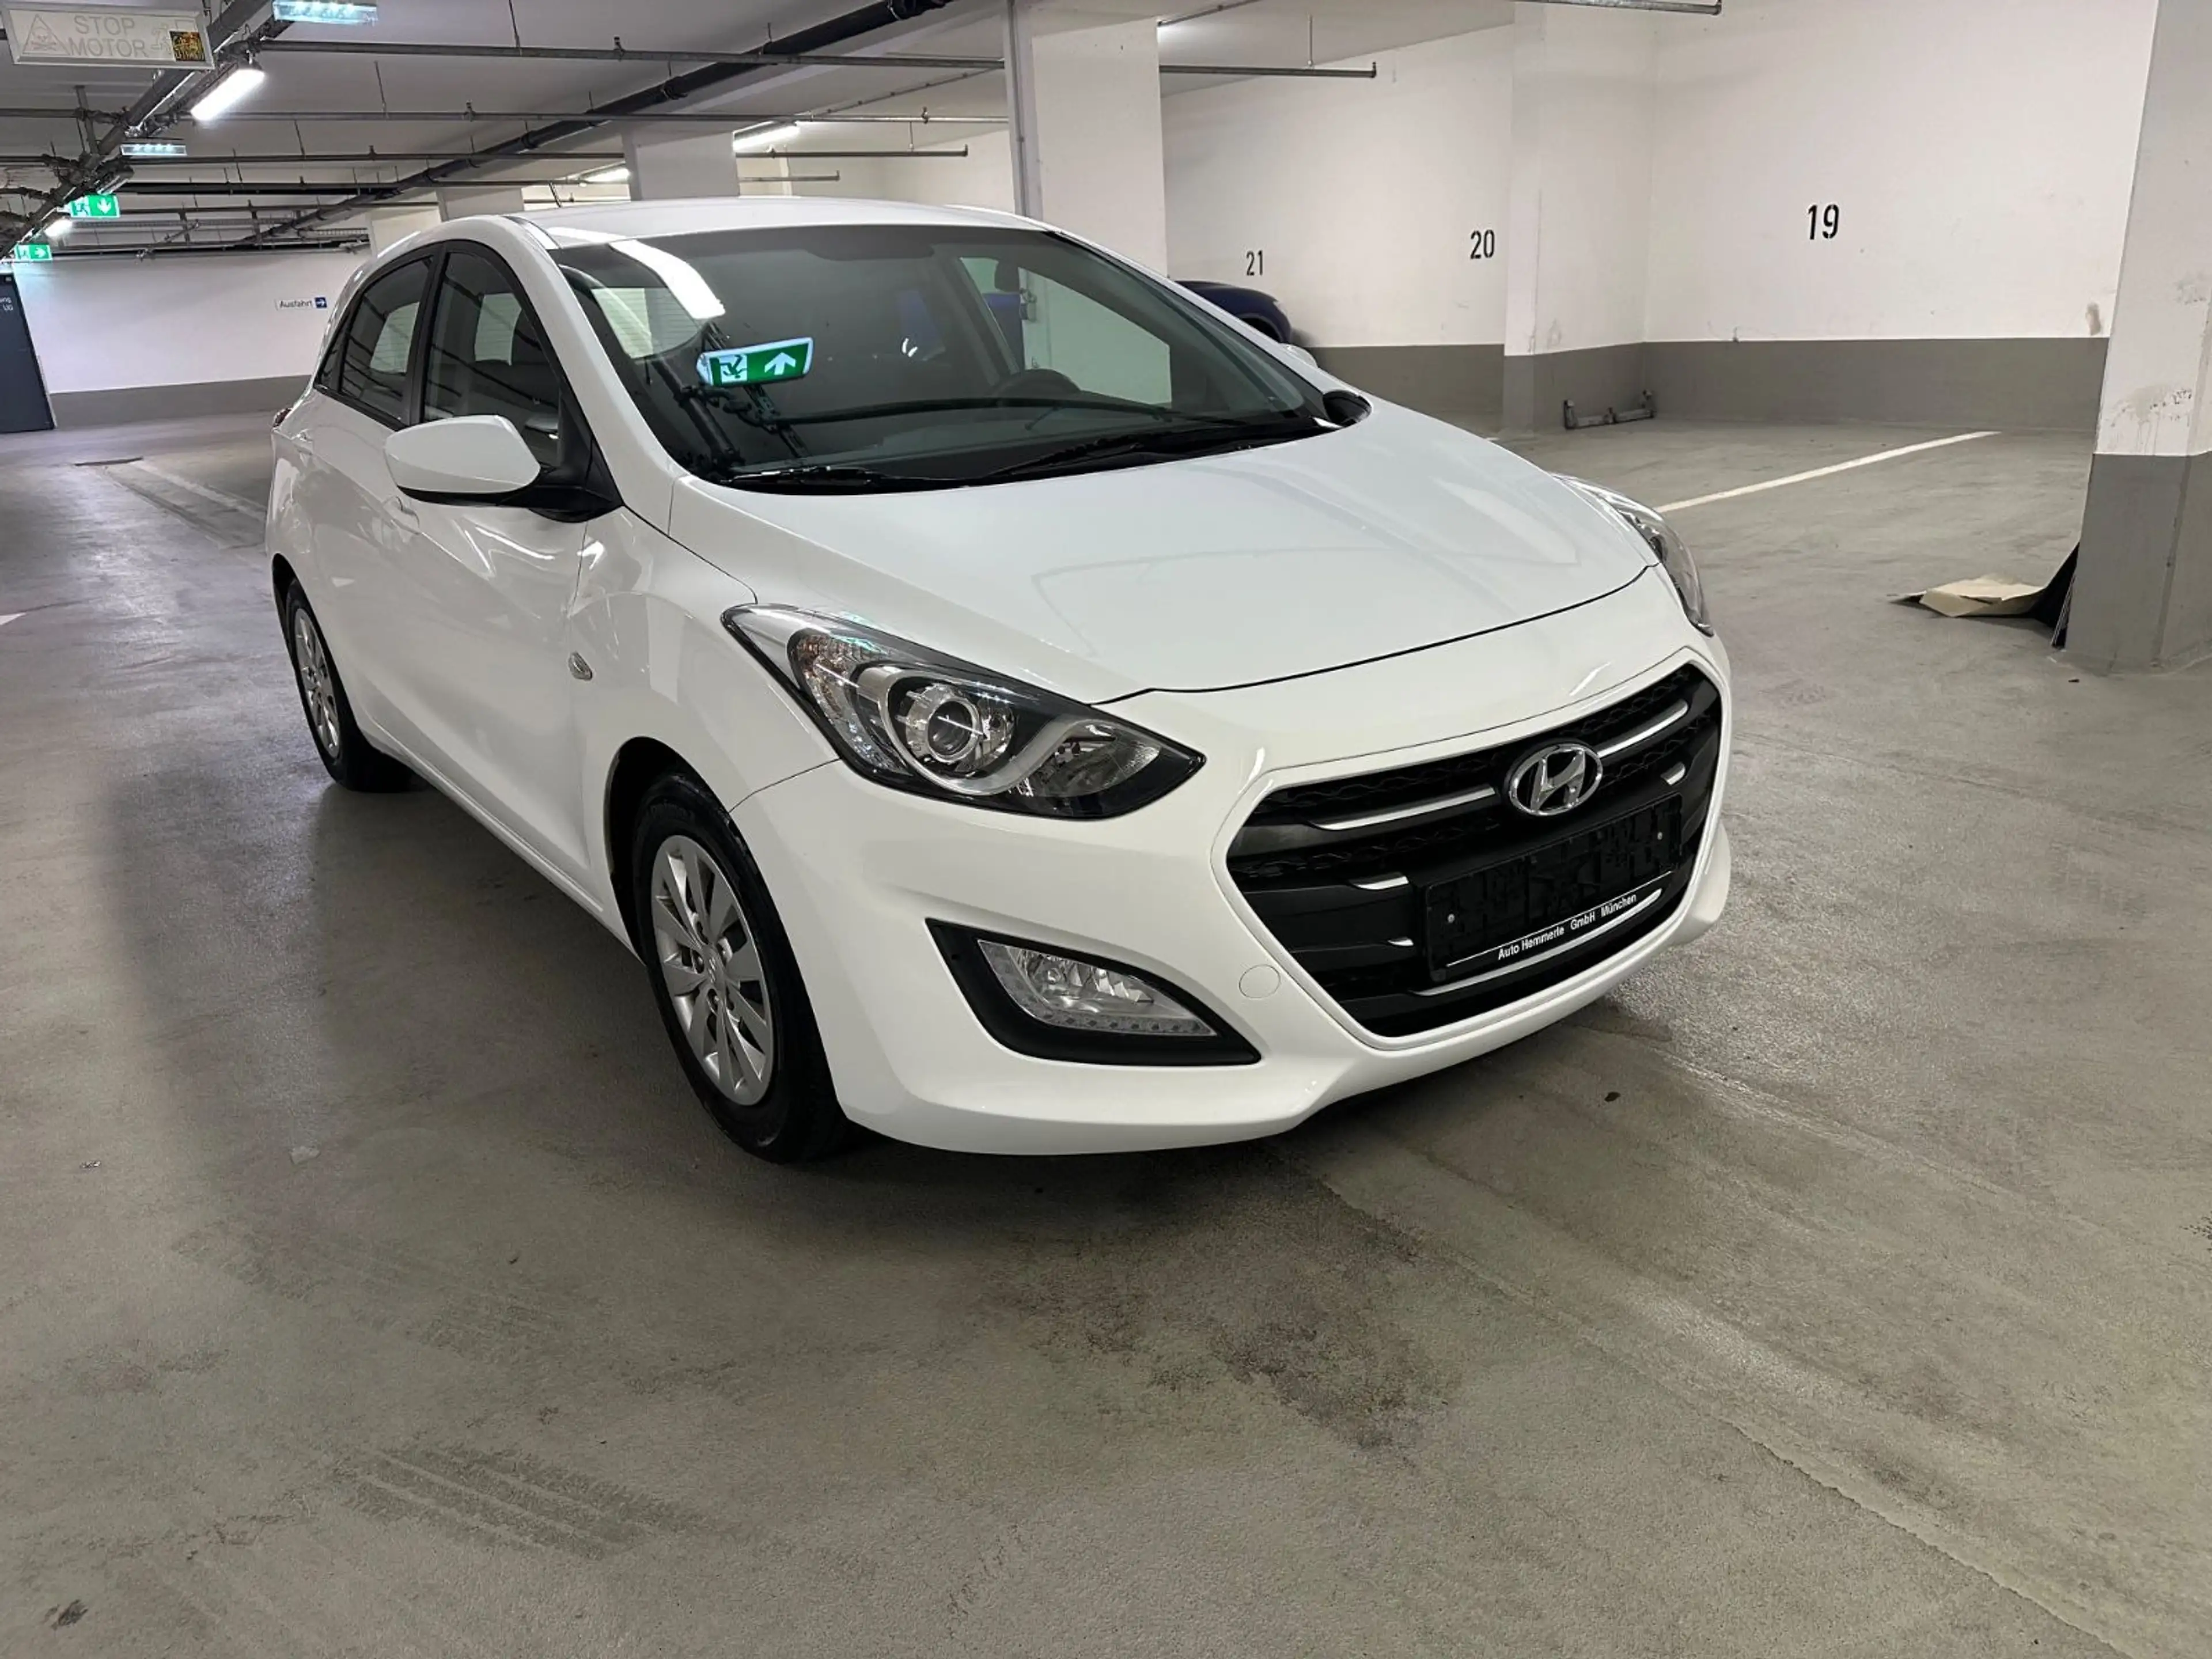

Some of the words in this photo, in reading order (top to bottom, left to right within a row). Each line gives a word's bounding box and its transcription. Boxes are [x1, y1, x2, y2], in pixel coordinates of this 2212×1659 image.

[74, 16, 135, 35] STOP
[67, 37, 149, 57] MOTOR
[1807, 204, 1839, 240] 19
[1470, 229, 1495, 259] 20
[1245, 250, 1264, 276] 21
[1498, 944, 1520, 960] Auto
[1570, 911, 1596, 931] GmbH
[1600, 893, 1637, 918] München
